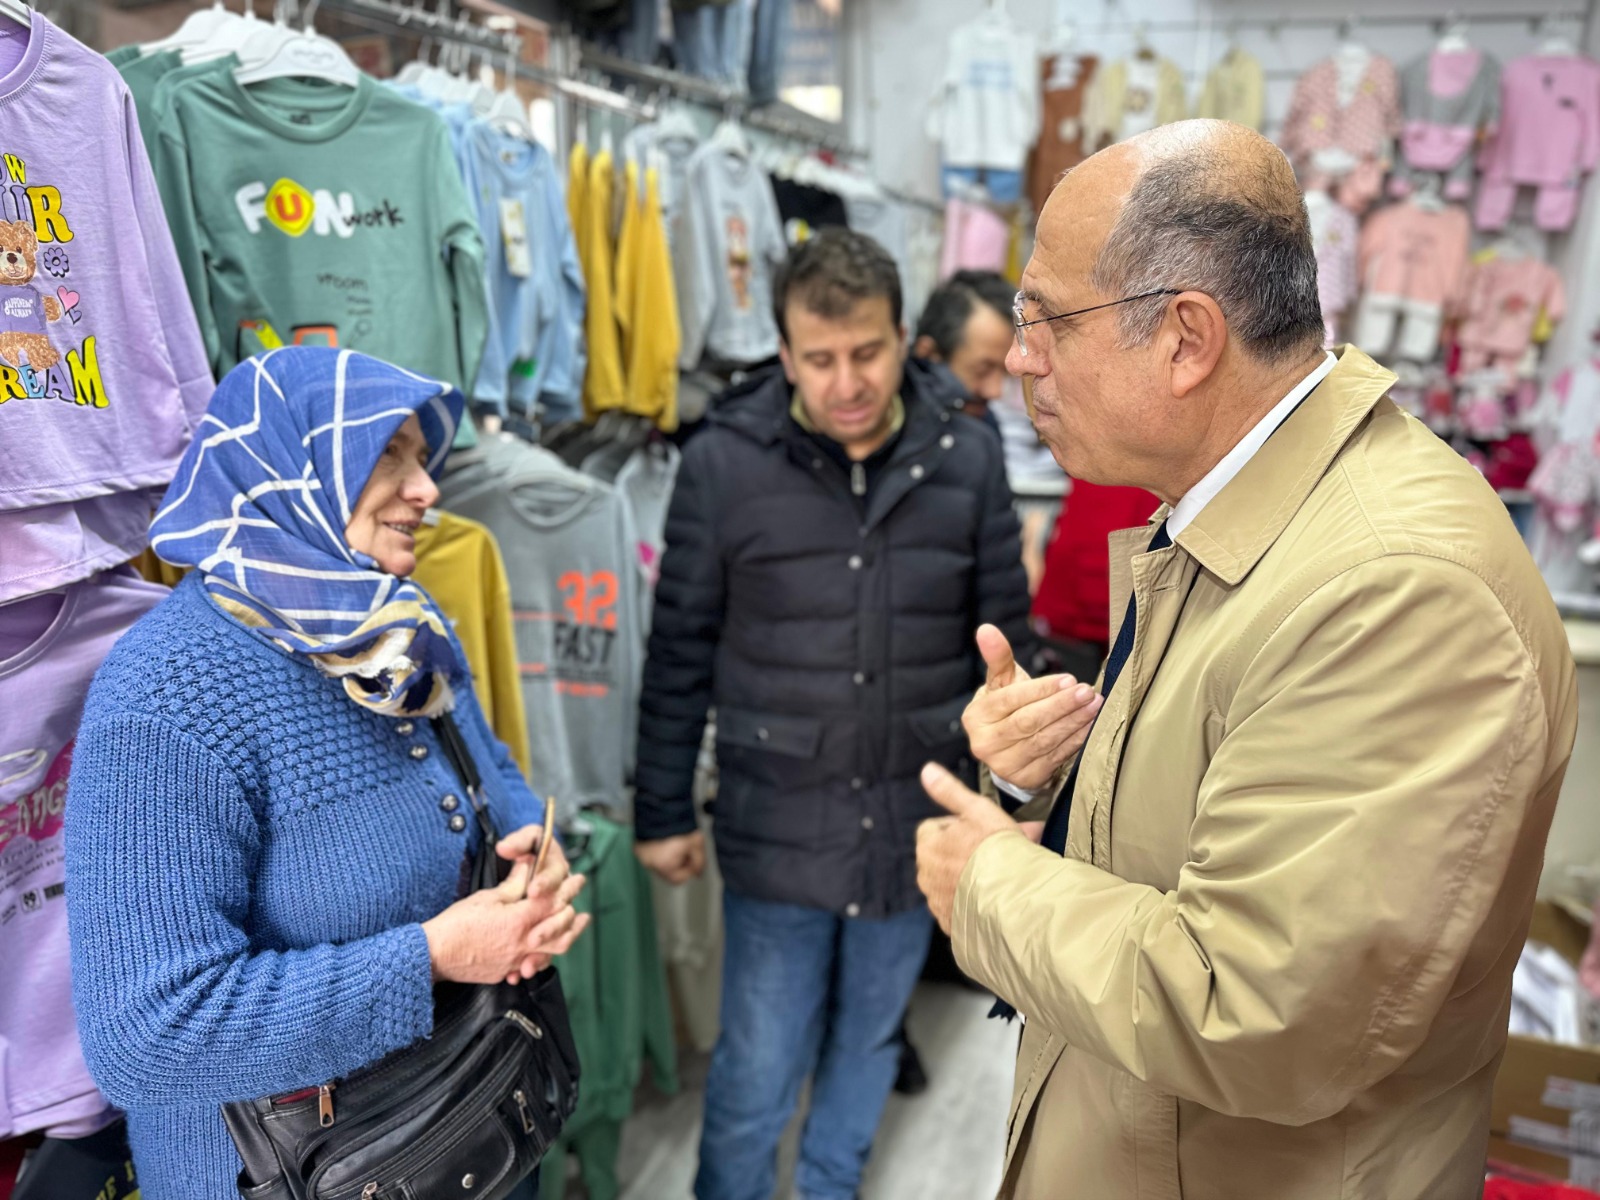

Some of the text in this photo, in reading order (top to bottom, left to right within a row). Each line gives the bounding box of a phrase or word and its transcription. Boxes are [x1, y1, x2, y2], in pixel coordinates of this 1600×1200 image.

[235, 179, 403, 238] FUN work
[556, 569, 619, 631] 32
[554, 621, 617, 664] FAST
